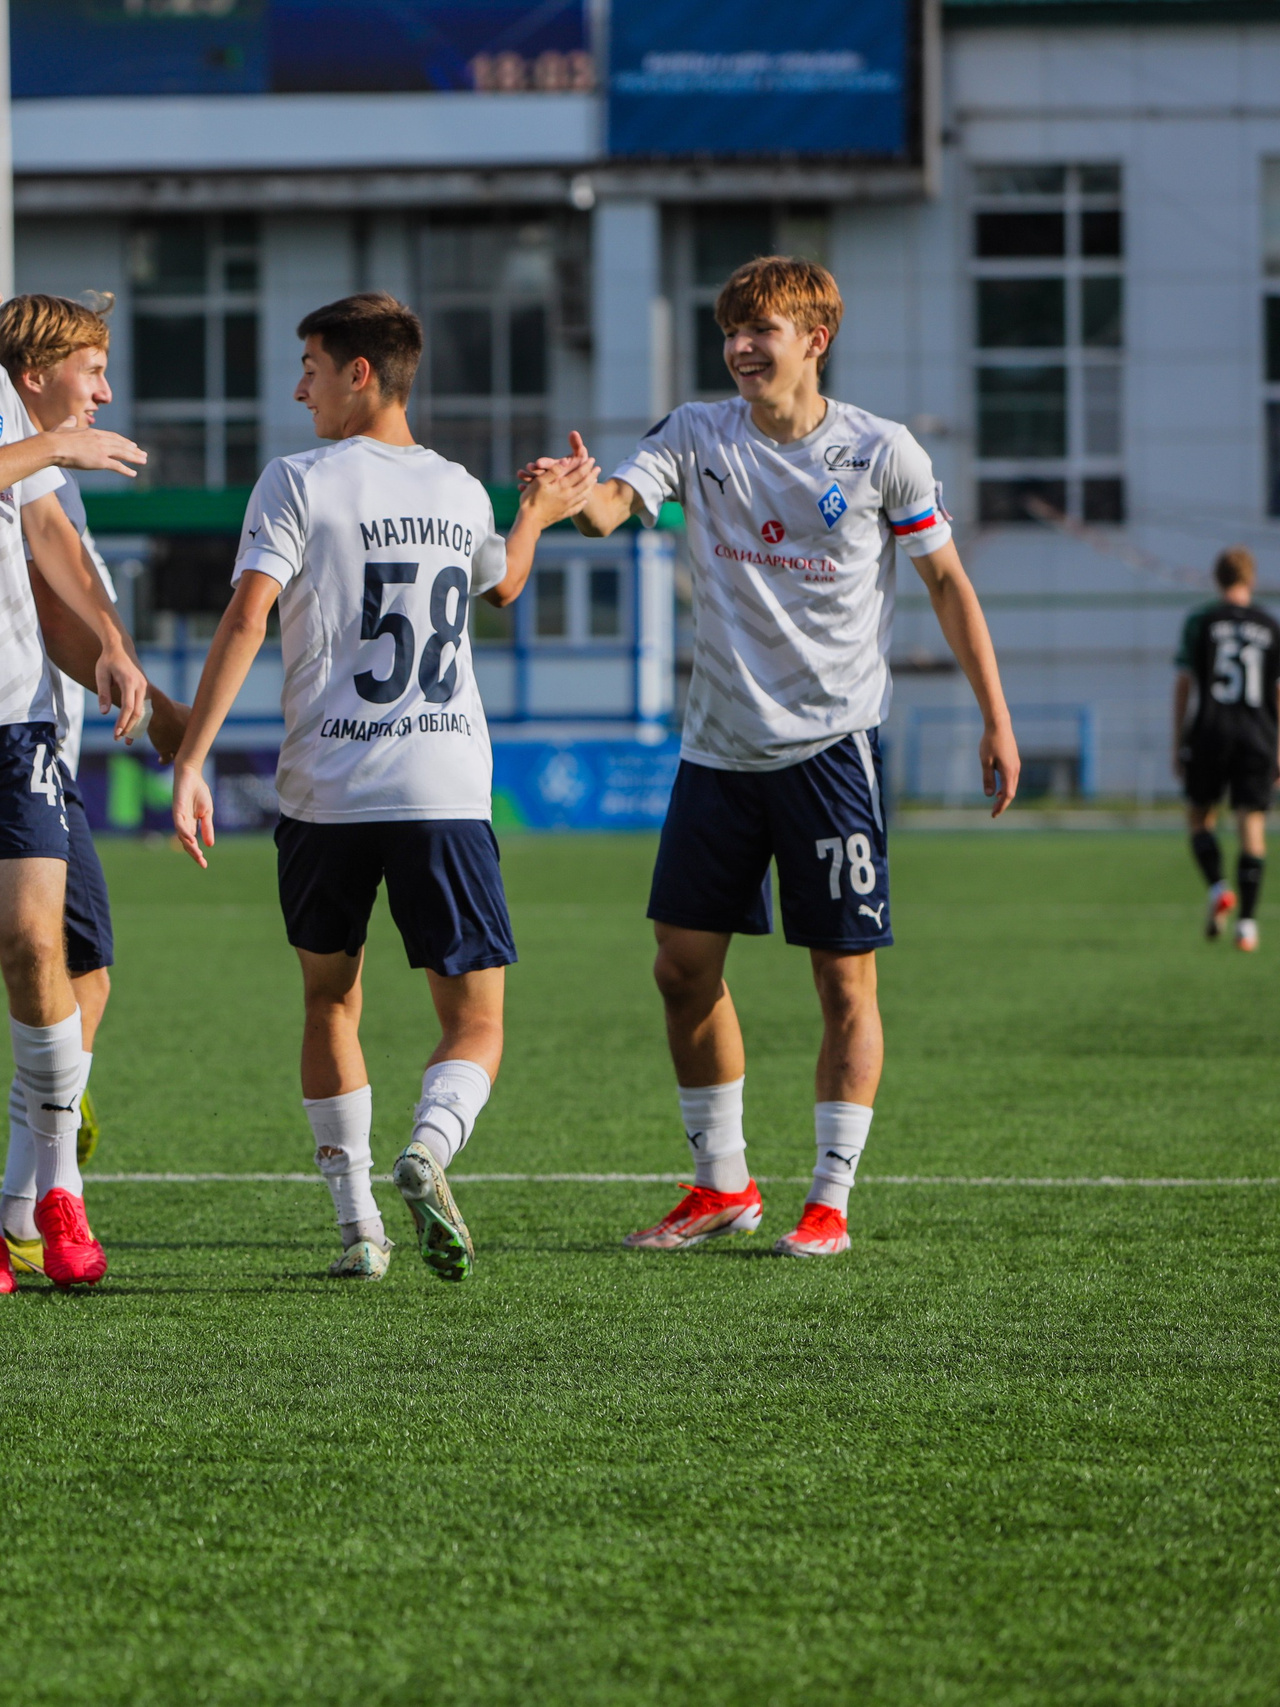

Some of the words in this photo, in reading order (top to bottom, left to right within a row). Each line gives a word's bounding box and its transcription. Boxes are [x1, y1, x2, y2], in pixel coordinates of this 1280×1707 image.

[359, 516, 474, 558] МАЛИКОВ
[714, 543, 837, 573] СОЛИДАРНОСТЬ
[804, 574, 836, 583] БАНК
[353, 561, 469, 705] 58
[1210, 638, 1265, 709] 51
[815, 832, 877, 900] 78
